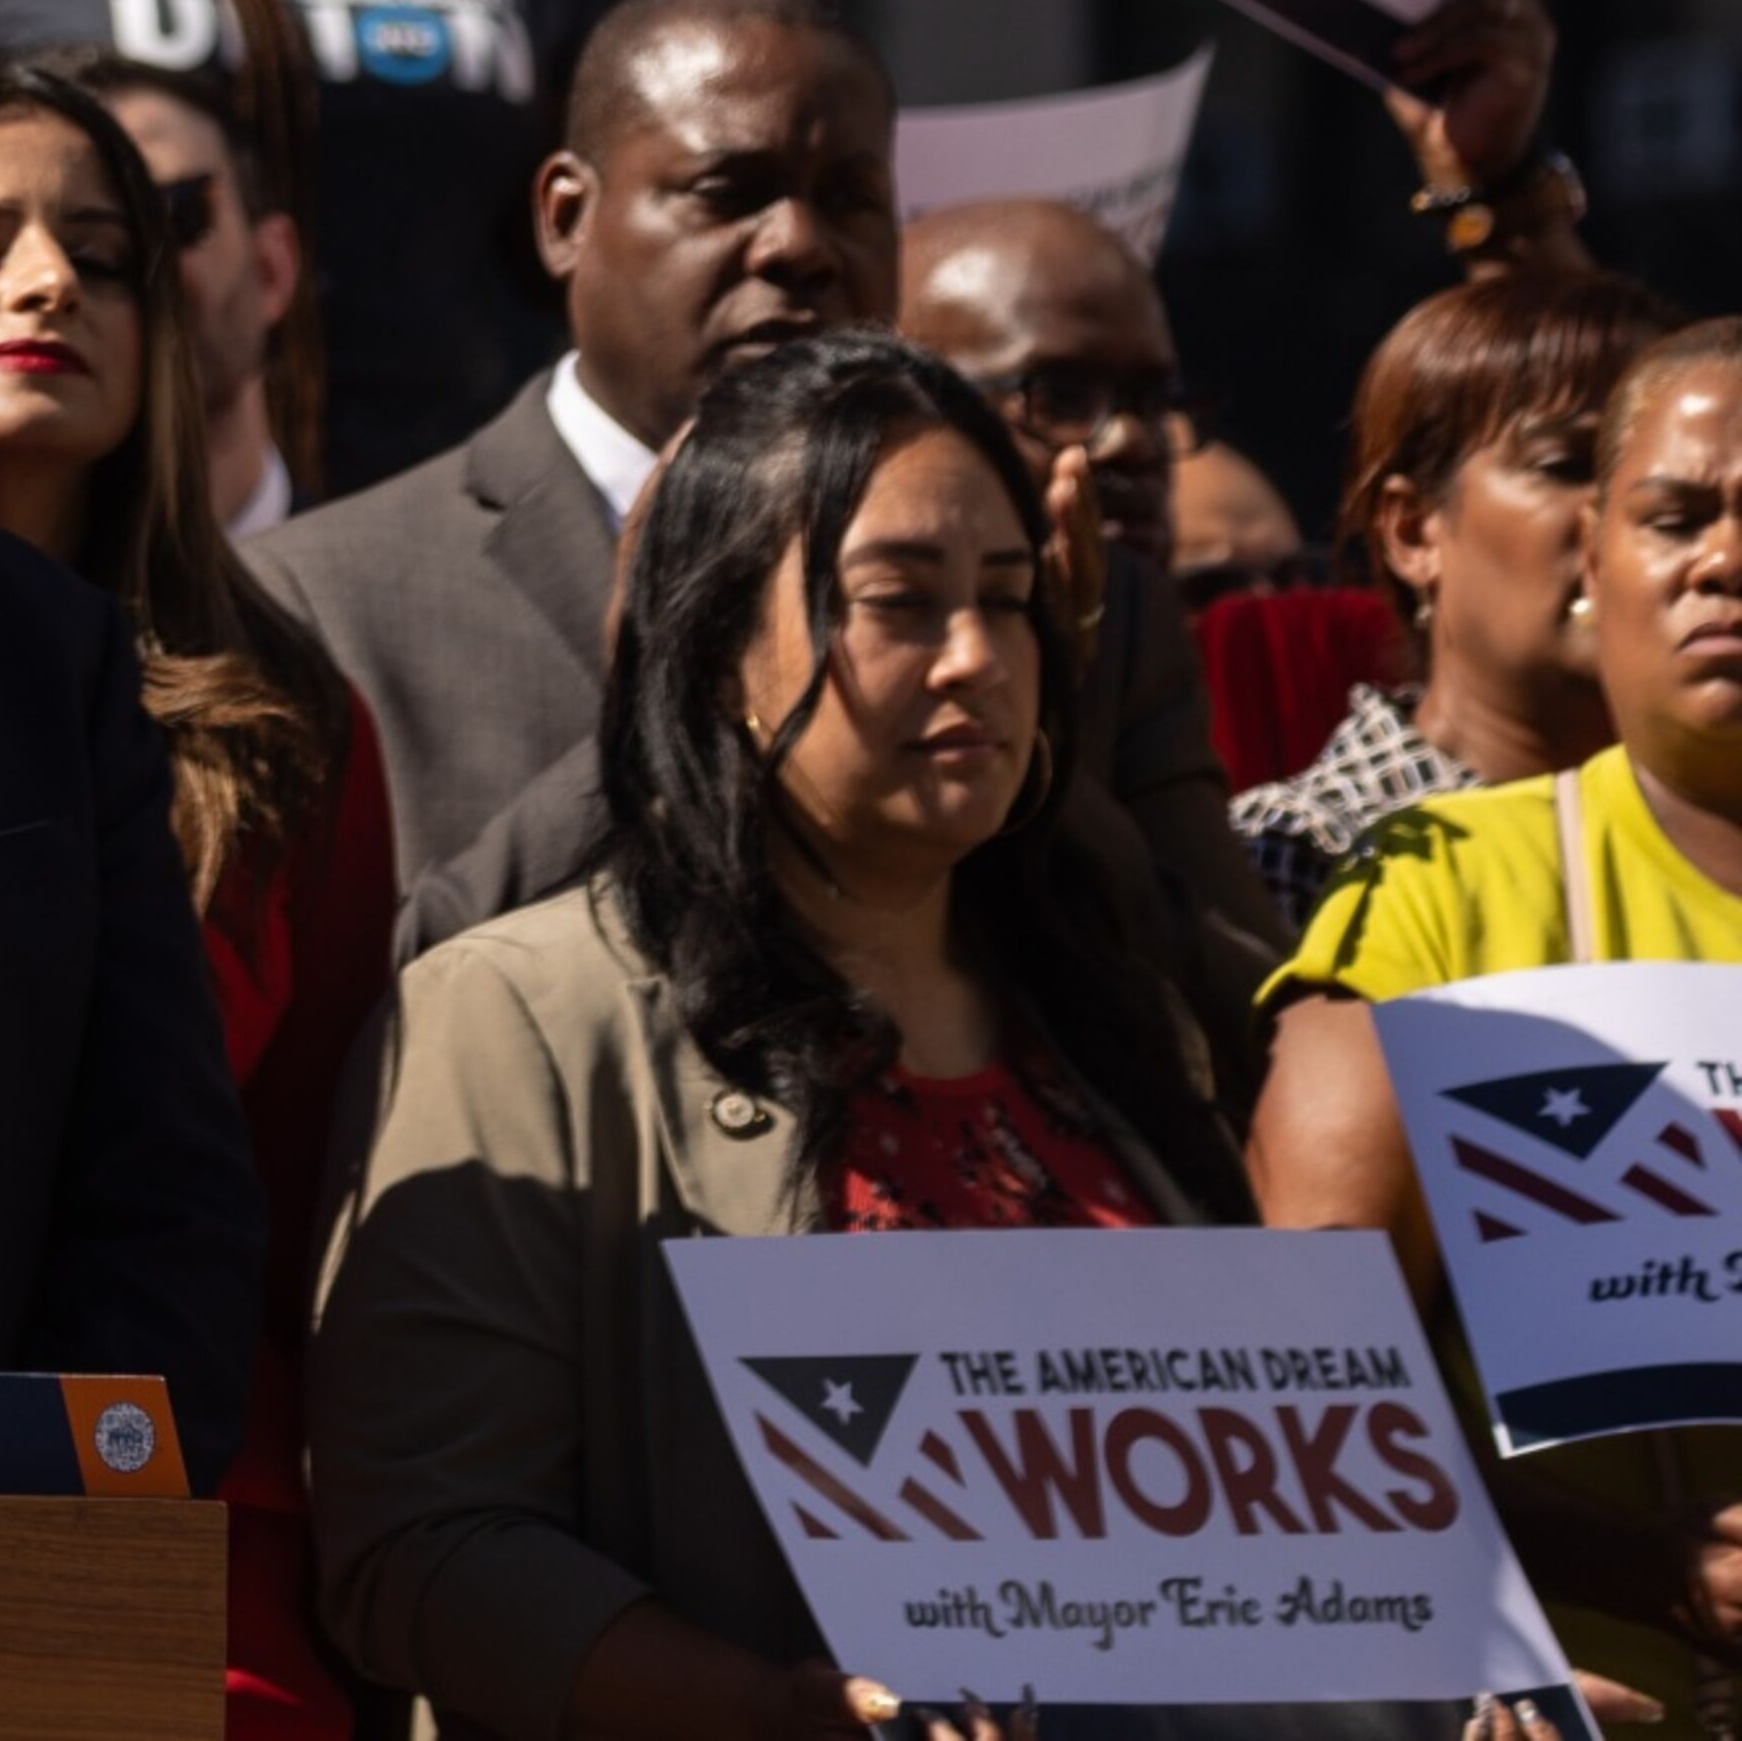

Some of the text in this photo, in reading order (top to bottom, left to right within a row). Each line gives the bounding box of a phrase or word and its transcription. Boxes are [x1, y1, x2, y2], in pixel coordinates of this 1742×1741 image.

[1587, 1255, 1720, 1303] with
[938, 1346, 1413, 1397] THE AMERICAN DREAM
[957, 1400, 1461, 1543] WORKS
[905, 1576, 1435, 1652] with Mayor Eric Adams
